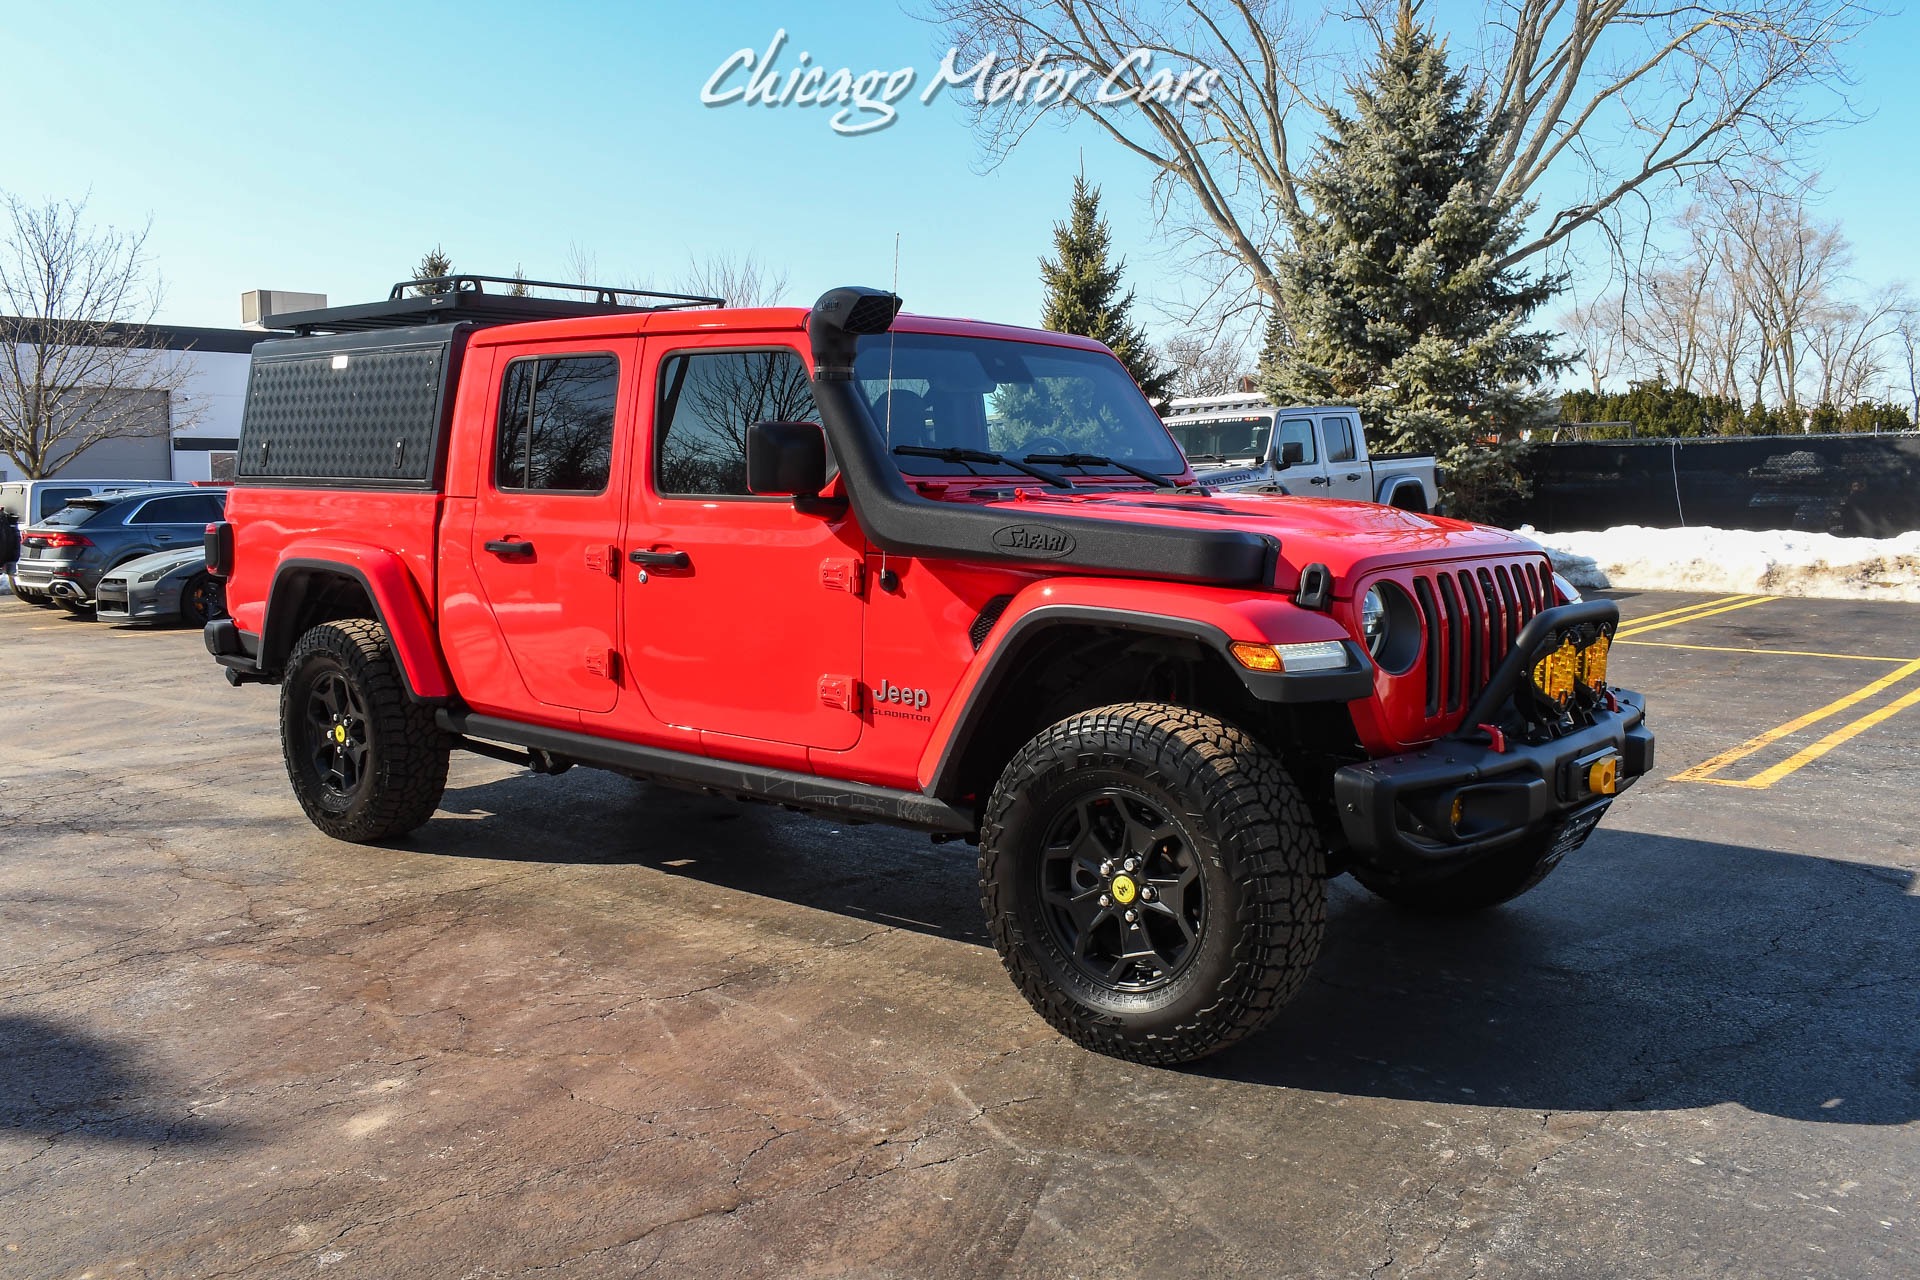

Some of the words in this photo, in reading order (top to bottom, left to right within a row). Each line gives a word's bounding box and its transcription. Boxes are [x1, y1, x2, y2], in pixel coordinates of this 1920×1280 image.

[1199, 473, 1251, 486] RUBICON
[1000, 528, 1067, 552] SAFARI
[873, 679, 929, 711] Jeep
[870, 707, 931, 722] GLADIATOR
